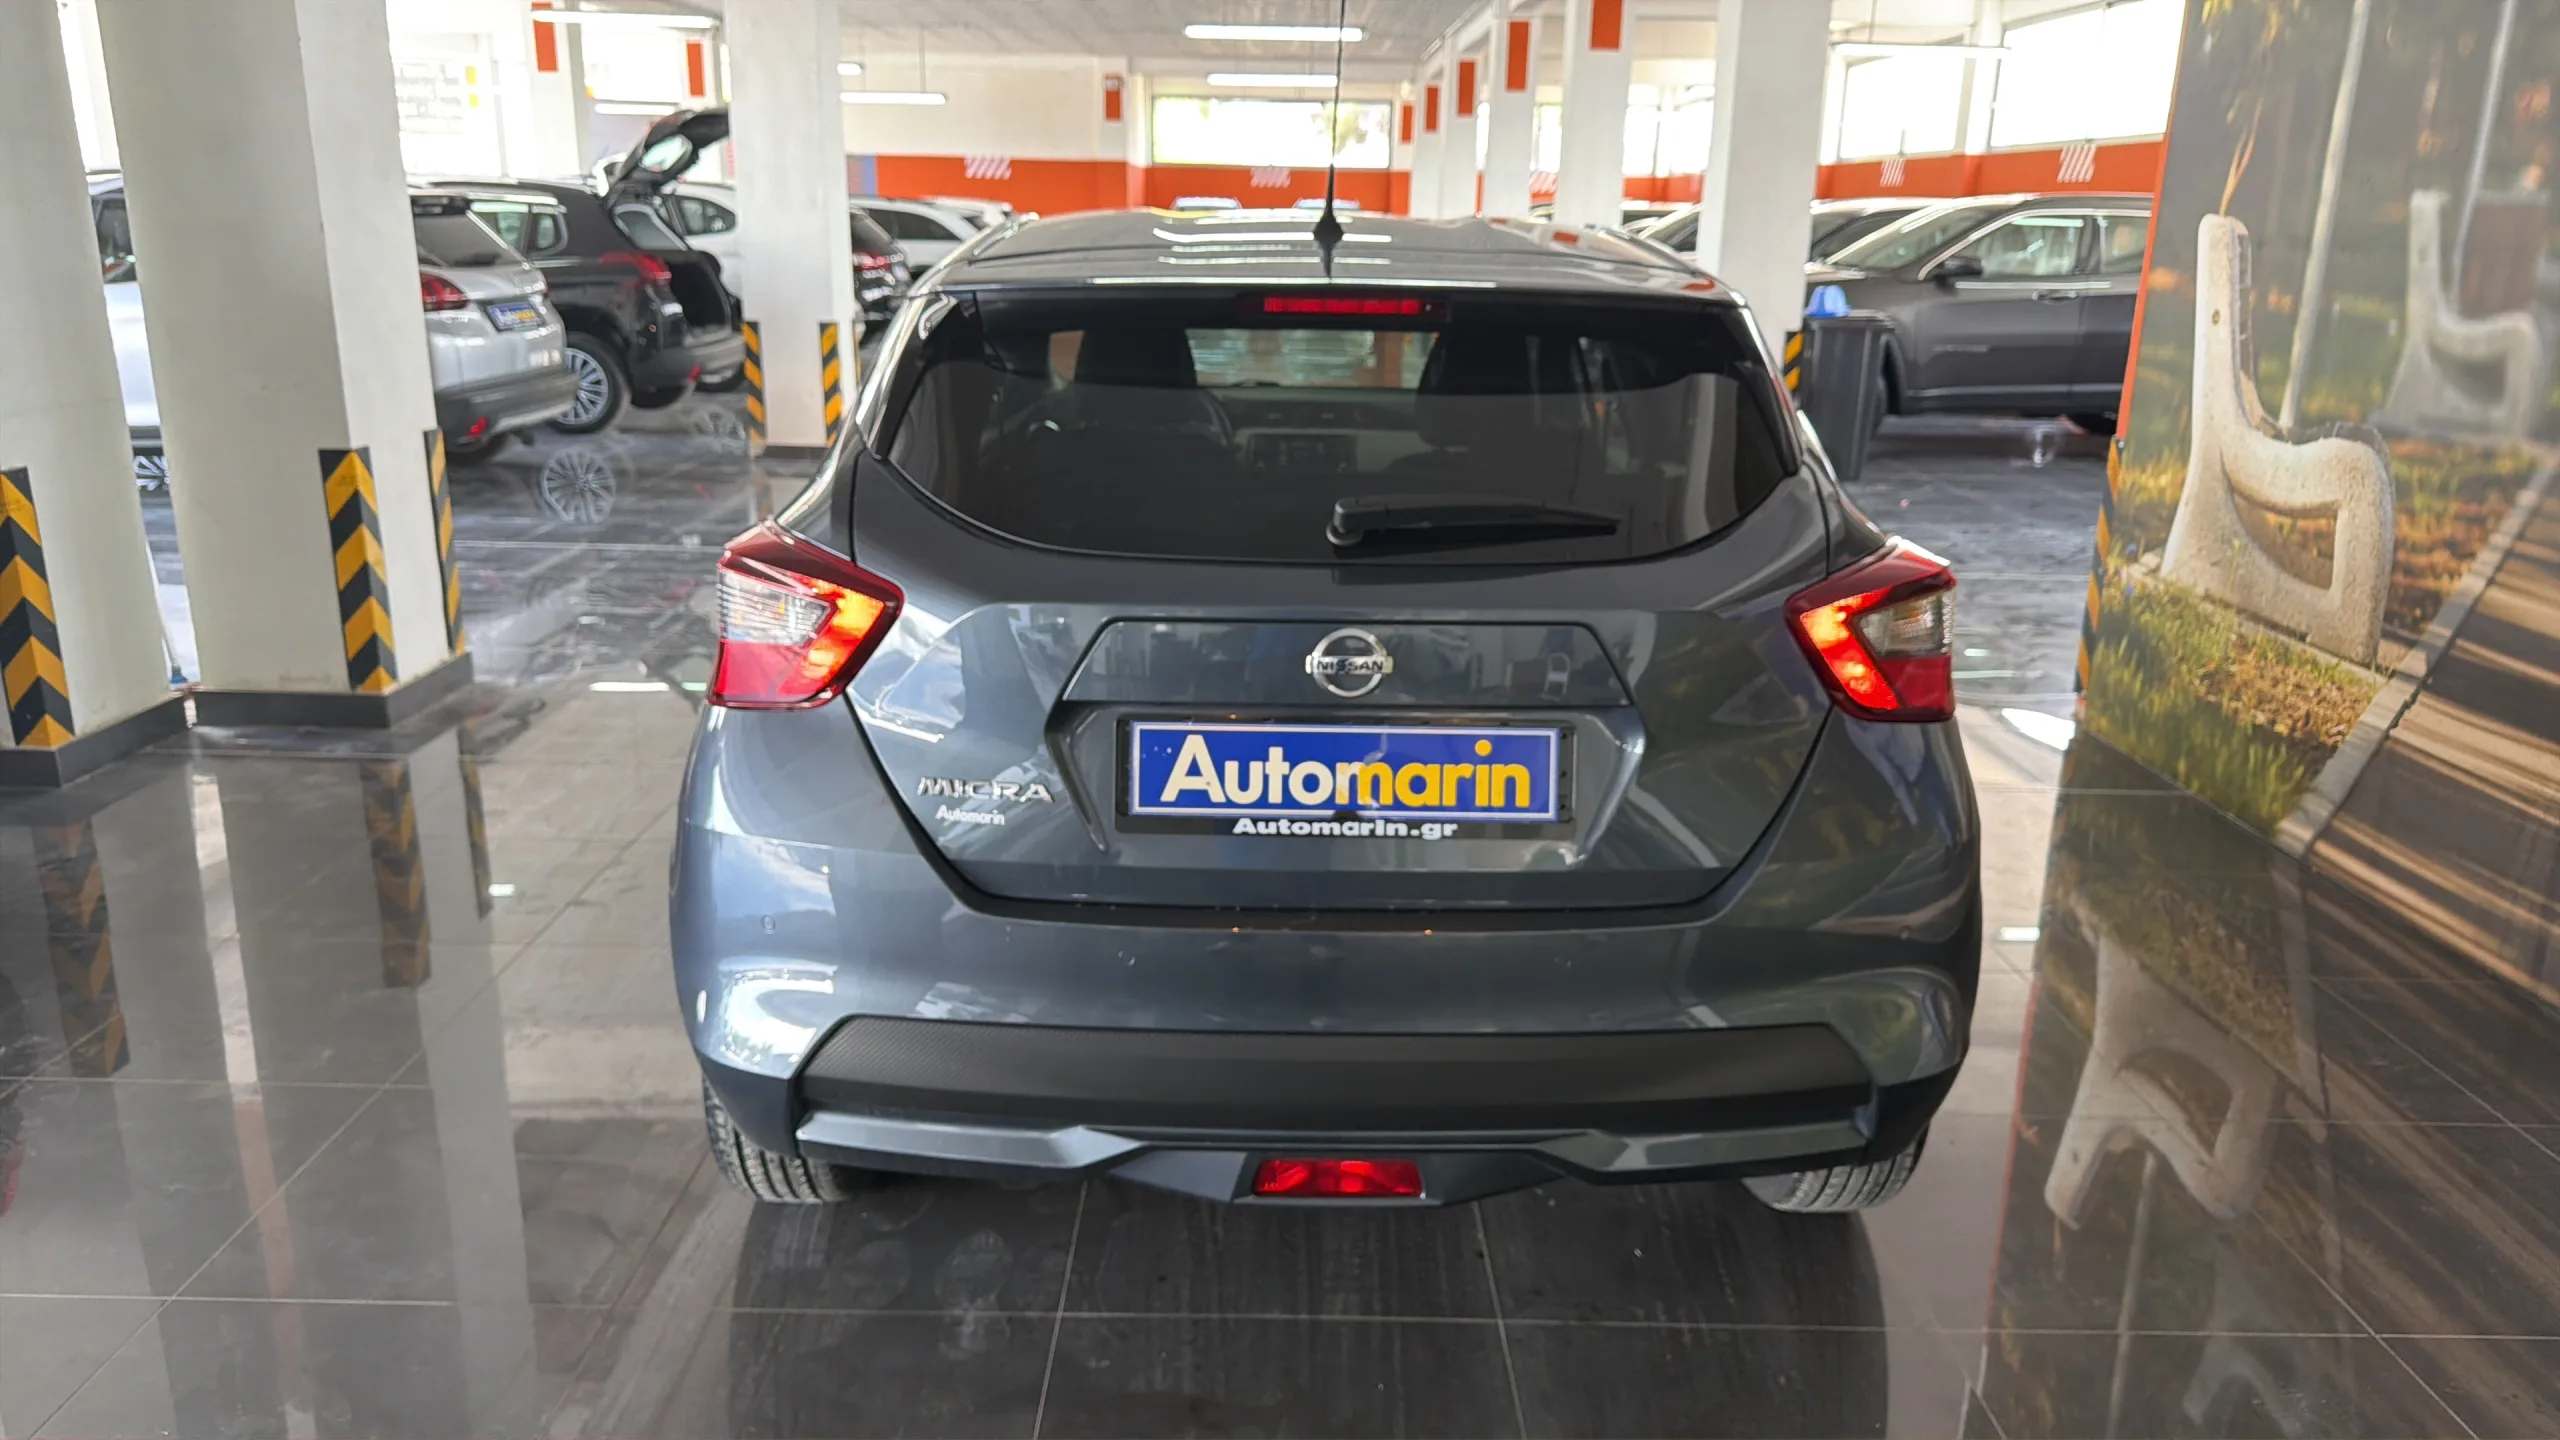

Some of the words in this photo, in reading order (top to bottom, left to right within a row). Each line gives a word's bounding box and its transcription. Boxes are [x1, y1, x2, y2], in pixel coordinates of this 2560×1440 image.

[1317, 659, 1384, 673] NISSAN
[1159, 733, 1532, 809] Automarin
[917, 776, 1055, 803] MICRA
[934, 804, 1006, 826] Automarin
[1232, 817, 1459, 841] Automarin.gr
